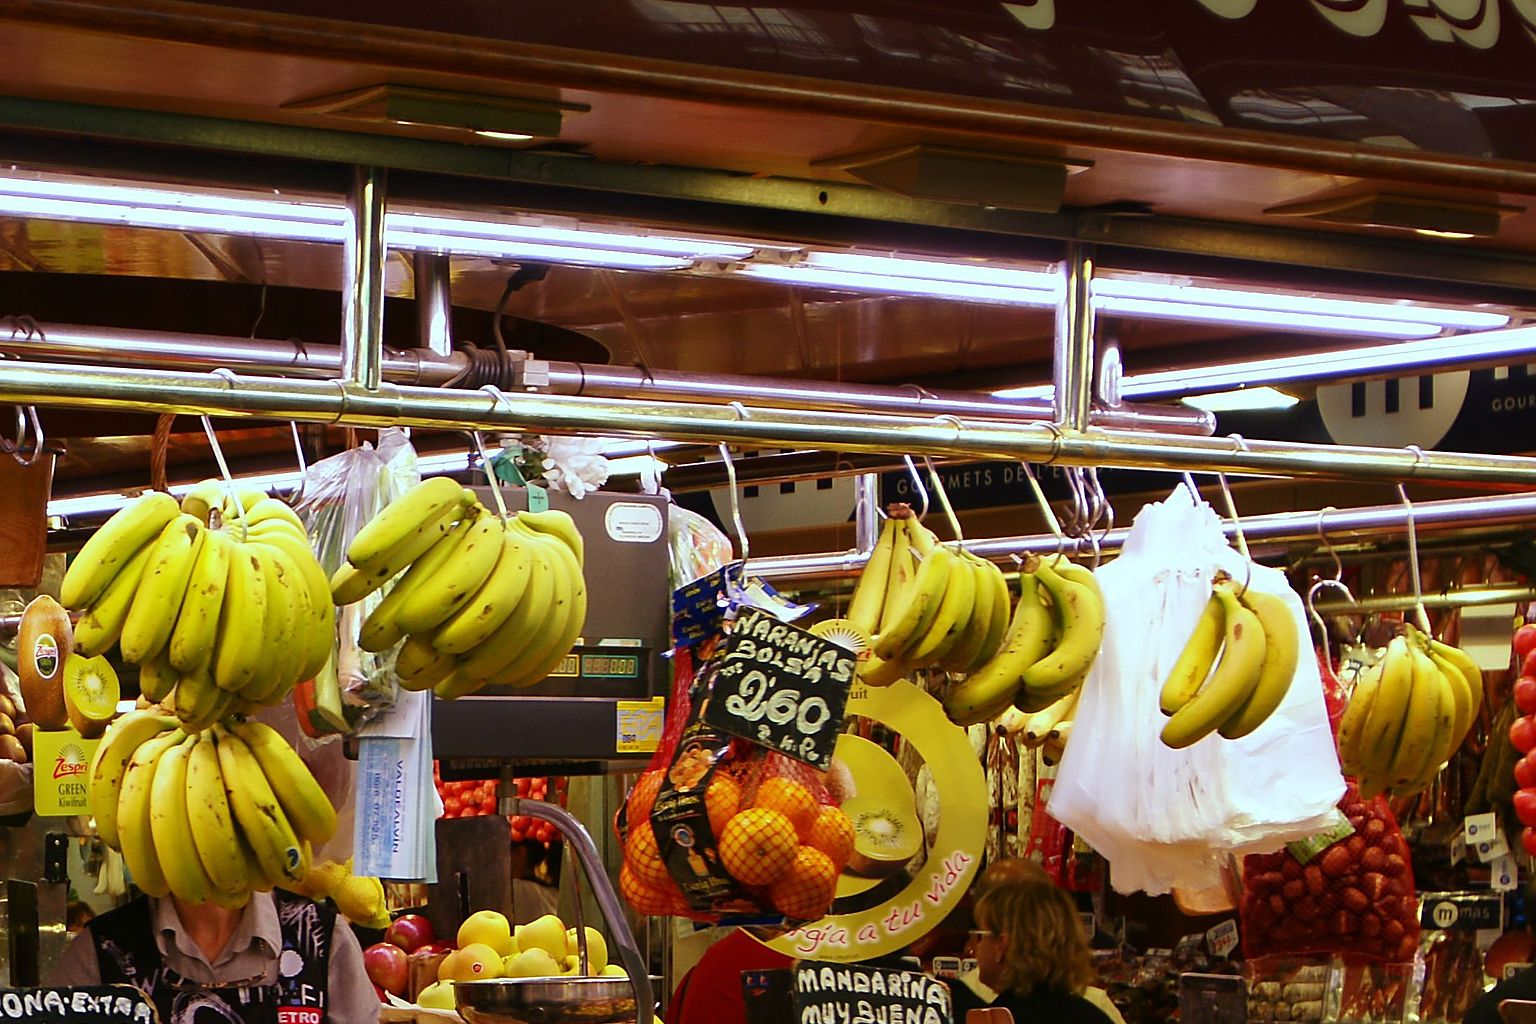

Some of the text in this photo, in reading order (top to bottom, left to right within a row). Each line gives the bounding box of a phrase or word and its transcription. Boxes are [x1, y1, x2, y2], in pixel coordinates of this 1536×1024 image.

[53, 756, 88, 779] Zespri
[58, 783, 87, 795] GREEN
[857, 925, 877, 941] a
[884, 903, 921, 931] tu
[927, 852, 971, 902] vida
